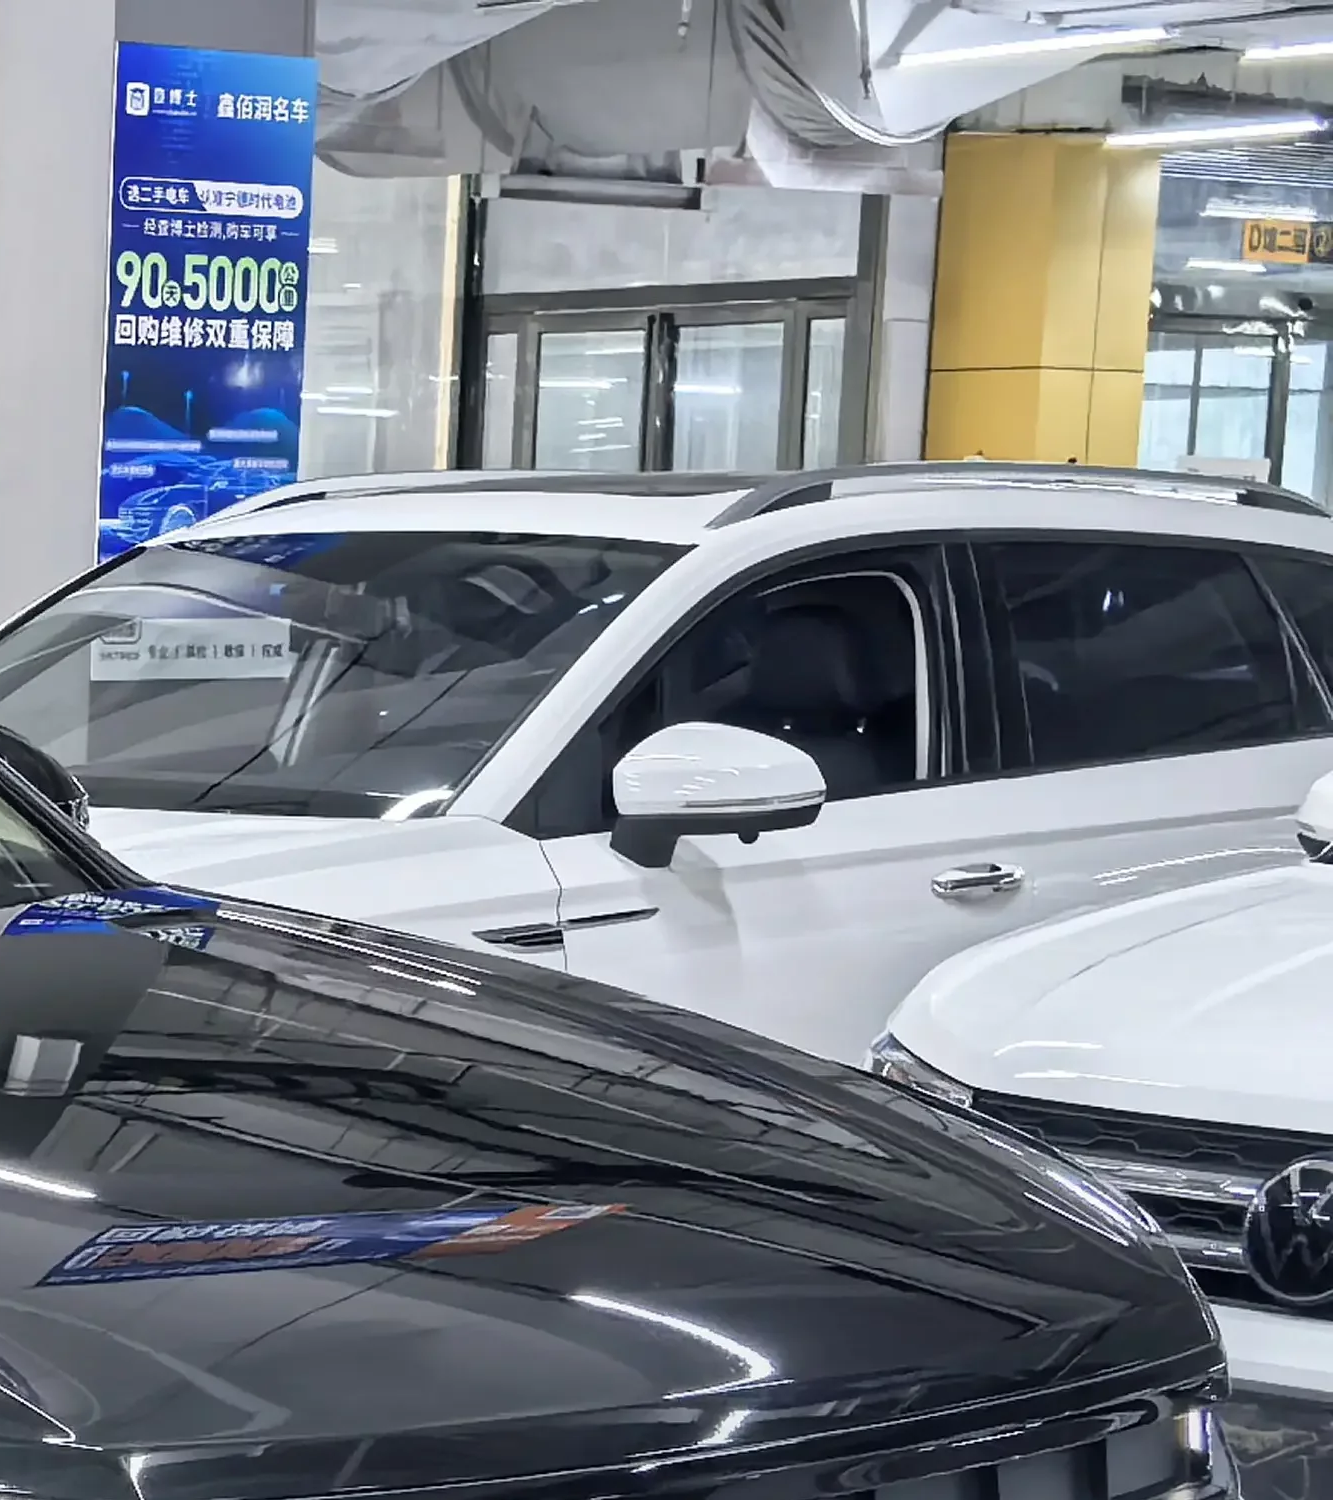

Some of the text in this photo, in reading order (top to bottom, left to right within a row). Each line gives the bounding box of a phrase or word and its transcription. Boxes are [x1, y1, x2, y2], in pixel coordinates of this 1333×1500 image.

[114, 314, 295, 351] 回购维修双重保障
